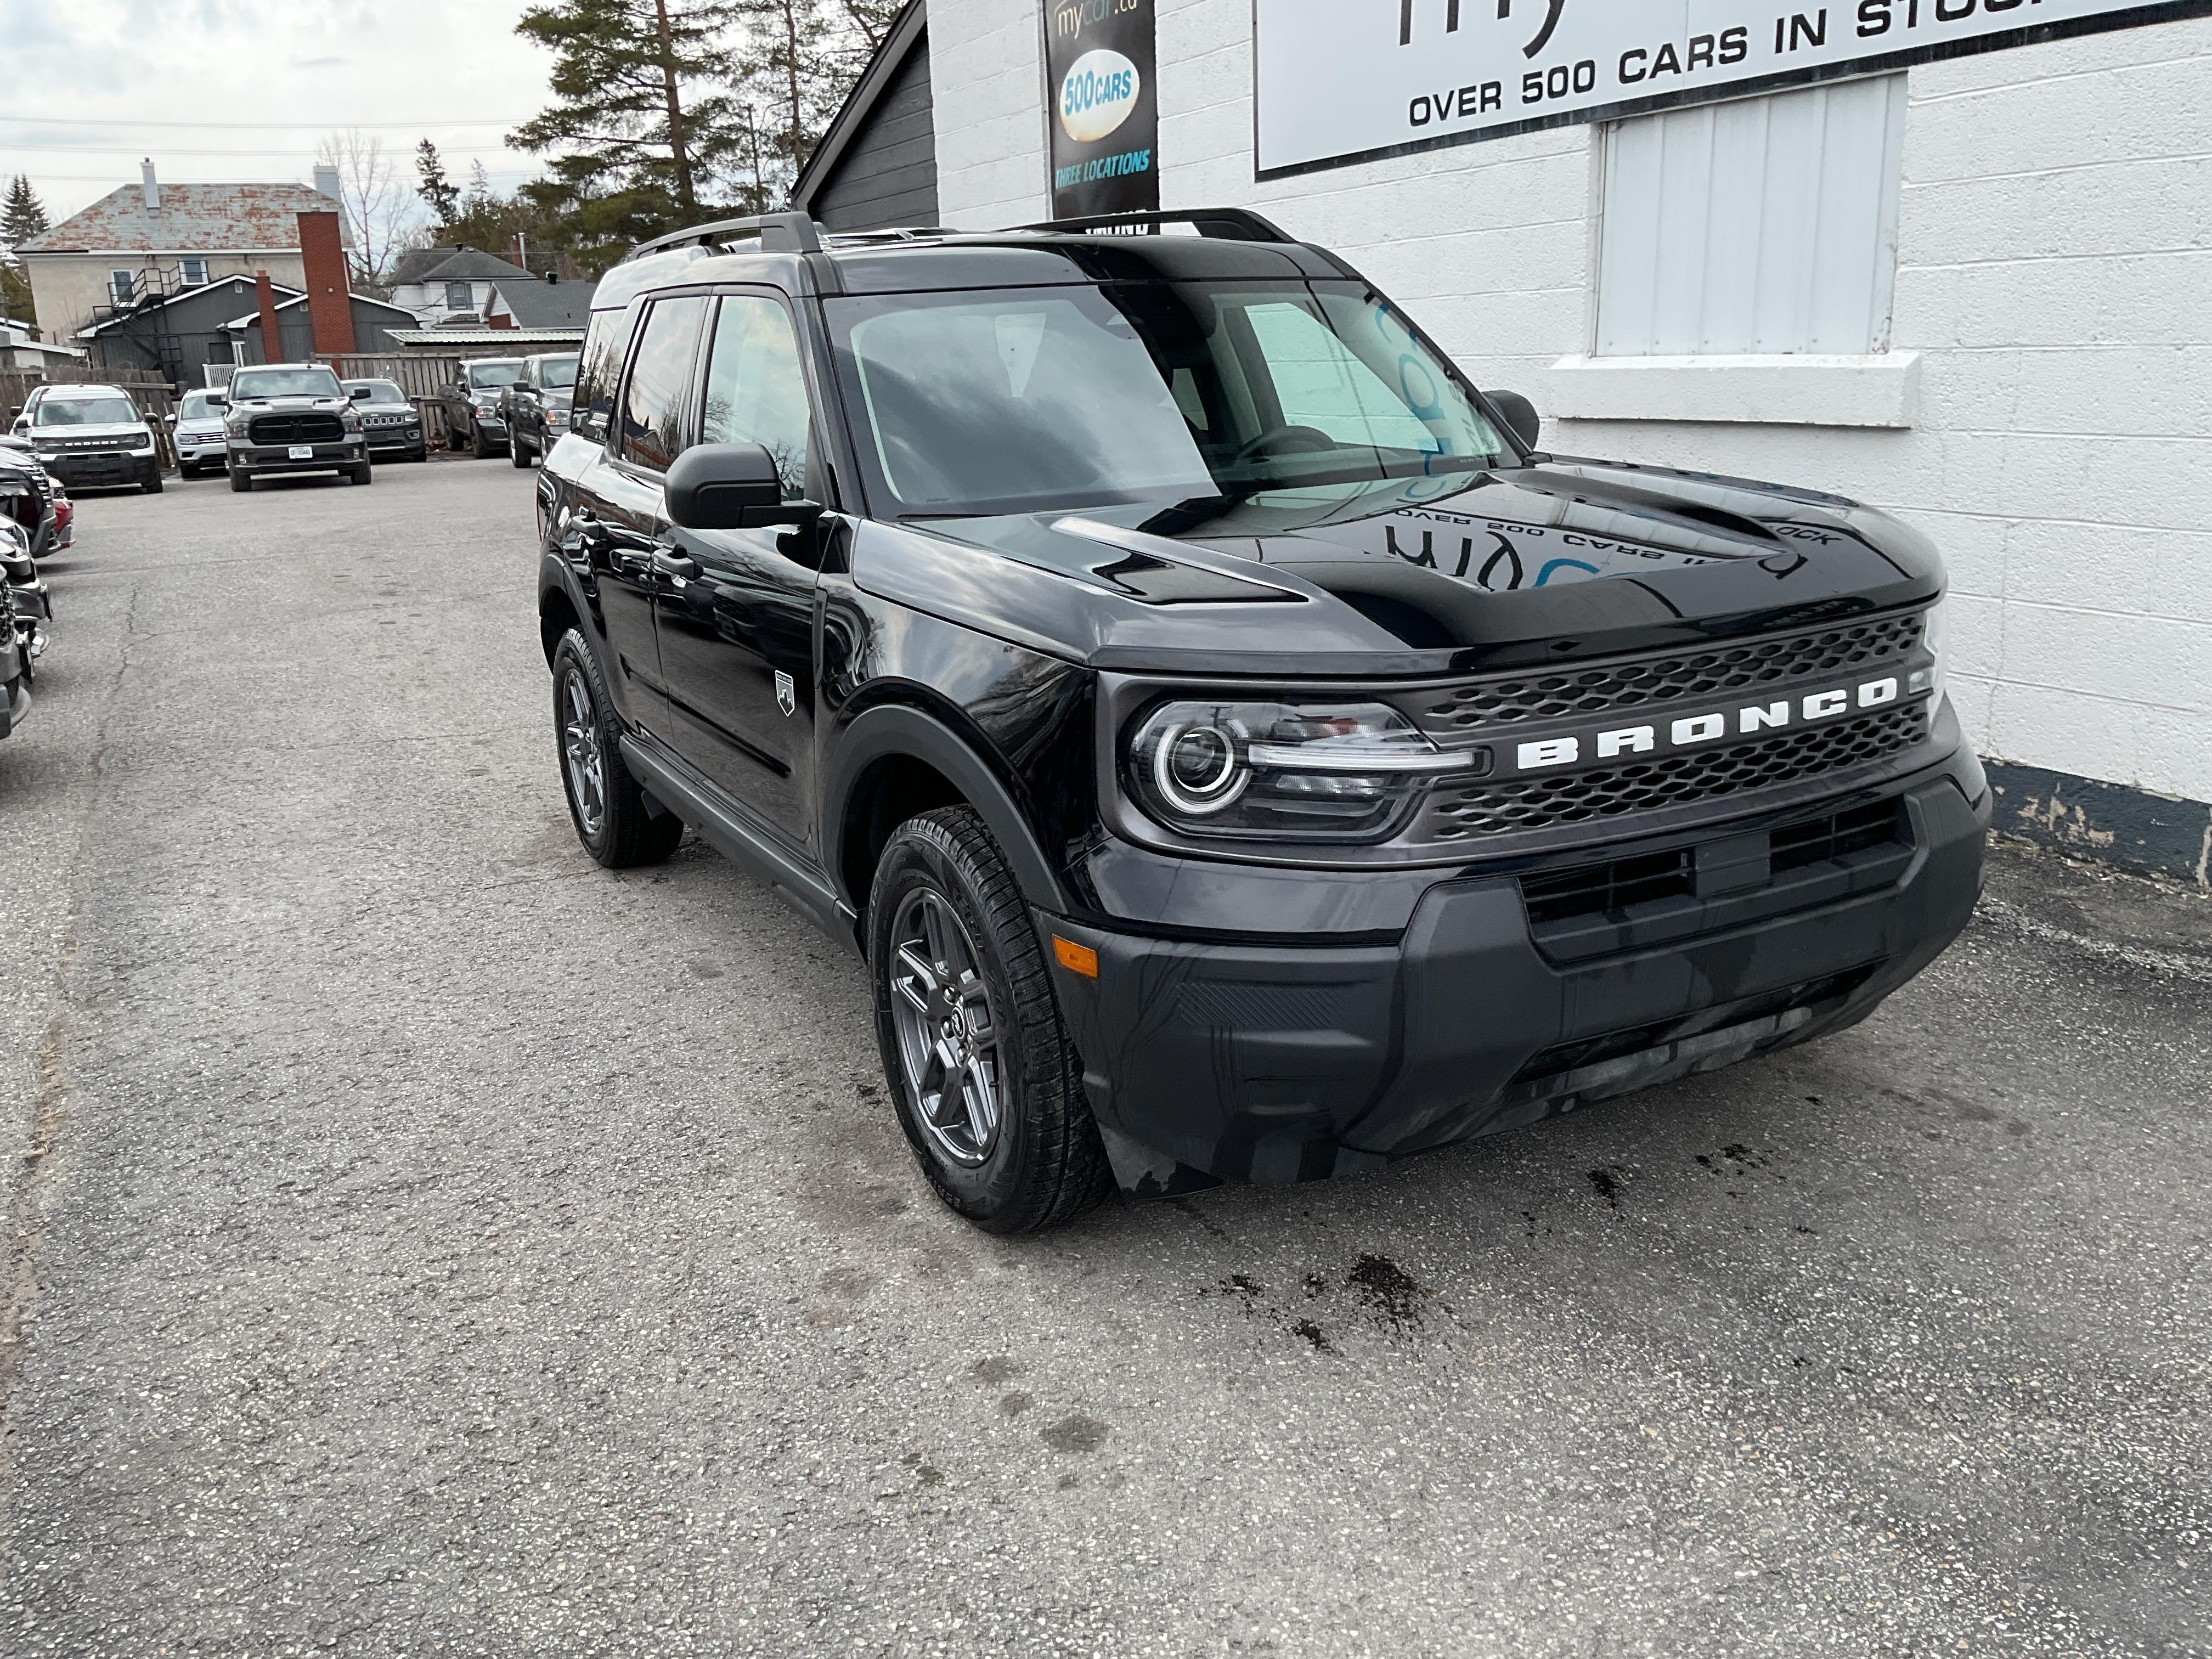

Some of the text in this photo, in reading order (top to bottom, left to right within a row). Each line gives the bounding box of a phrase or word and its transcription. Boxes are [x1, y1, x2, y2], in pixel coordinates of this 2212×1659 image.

[1410, 0, 2040, 126] OVER 500 CARS IN STO
[1056, 149, 1151, 189] THREE LOCATIONS
[1517, 678, 1898, 769] BRONCO
